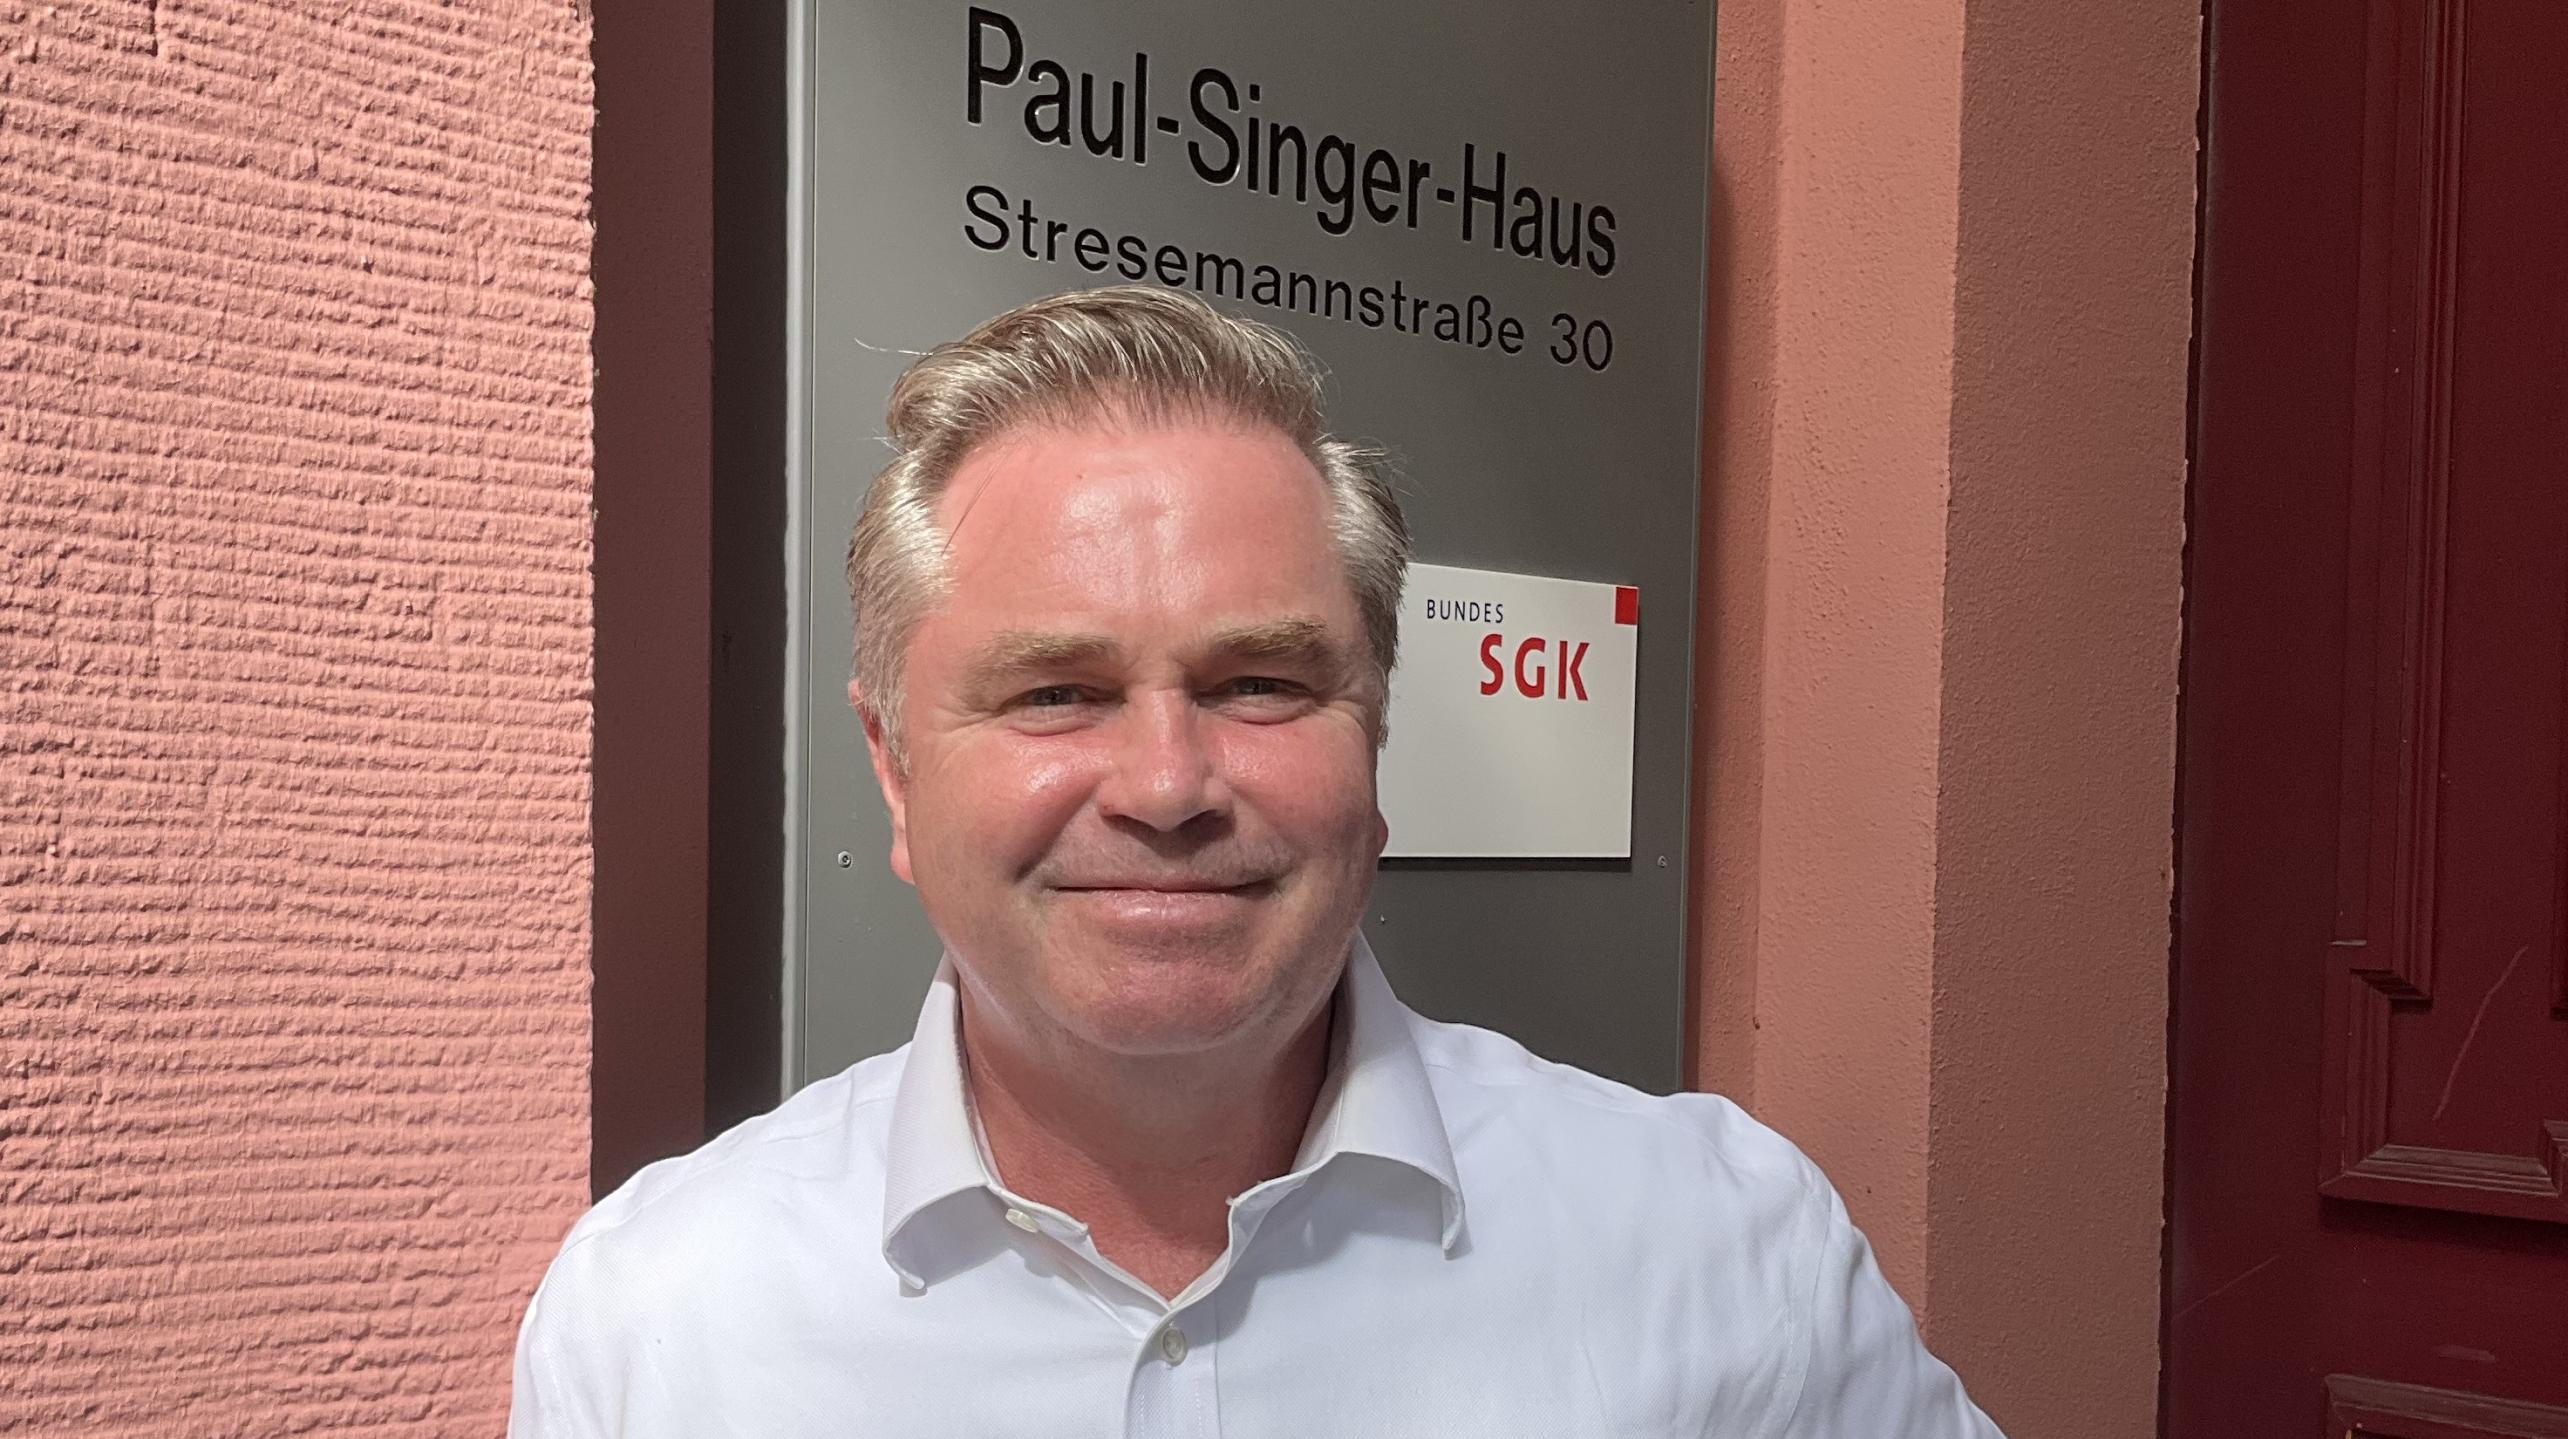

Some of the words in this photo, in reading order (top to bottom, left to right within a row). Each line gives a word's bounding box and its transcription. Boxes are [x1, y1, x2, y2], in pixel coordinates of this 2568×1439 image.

[967, 6, 1617, 277] Paul-Singer-Haus
[964, 185, 1524, 354] Stresemannstraße
[1550, 313, 1613, 371] 30
[1426, 599, 1504, 623] BUNDES
[1480, 633, 1590, 701] SGK
